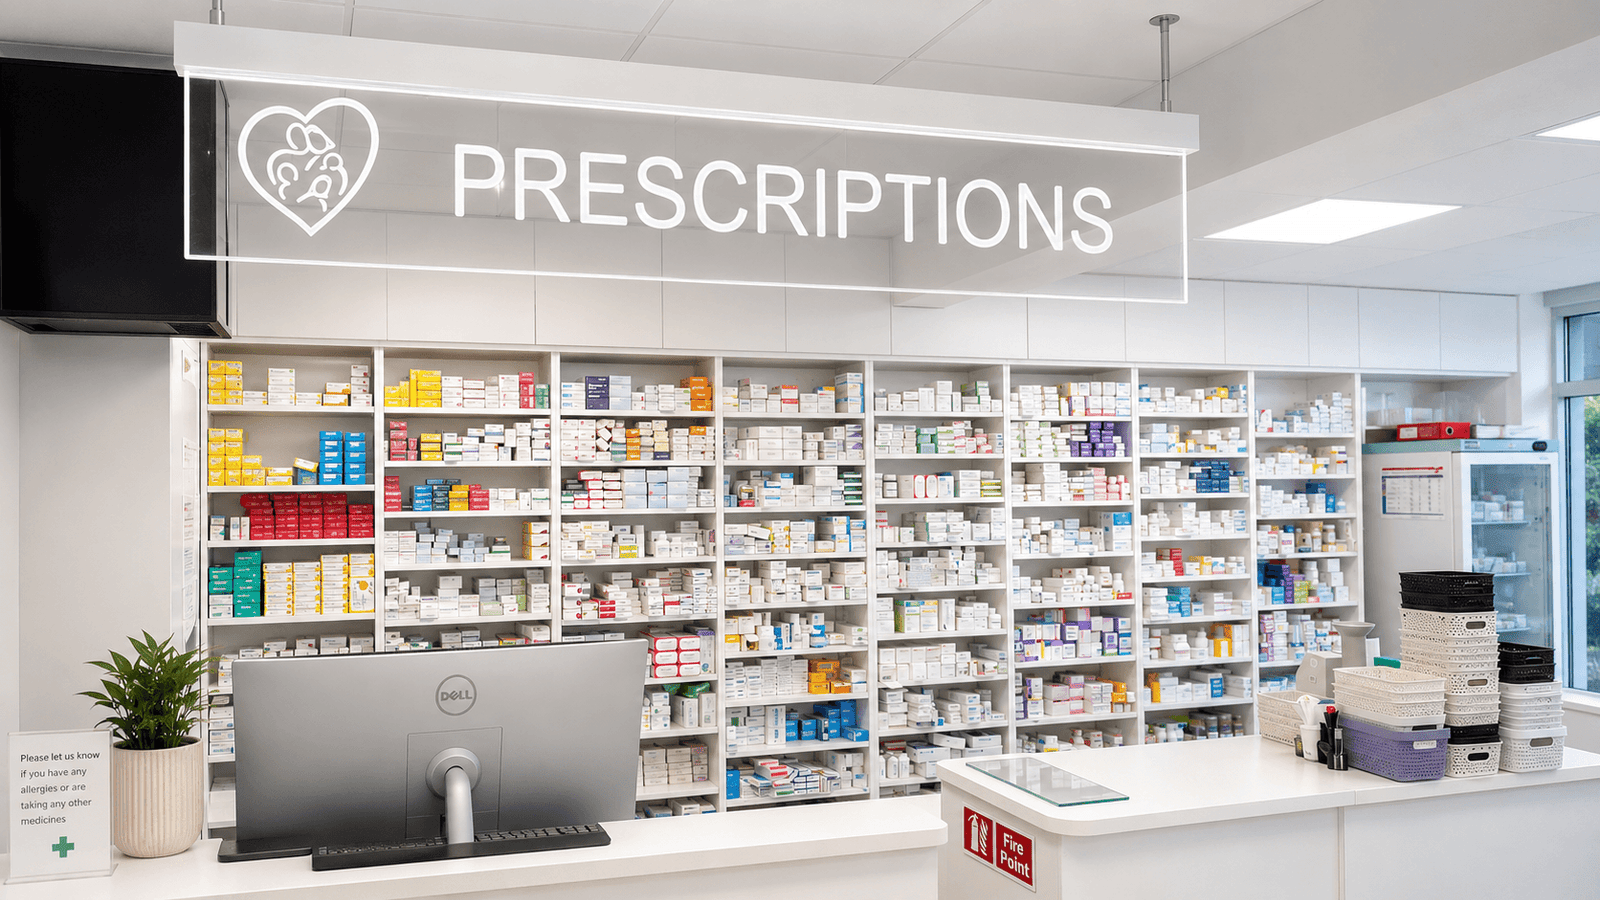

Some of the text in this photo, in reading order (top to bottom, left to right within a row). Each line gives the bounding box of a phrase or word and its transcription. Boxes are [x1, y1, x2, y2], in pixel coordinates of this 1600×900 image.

[452, 142, 1114, 255] PRESCRIPTIONS
[441, 689, 473, 701] DELL
[20, 754, 49, 762] Please
[51, 753, 62, 761] let
[77, 752, 100, 760] know
[20, 768, 87, 779] if you have any
[21, 785, 58, 795] allergies
[21, 798, 92, 810] taking any other
[21, 816, 66, 825] medicines
[1003, 833, 1024, 855] Fire
[1001, 850, 1030, 878] Point
